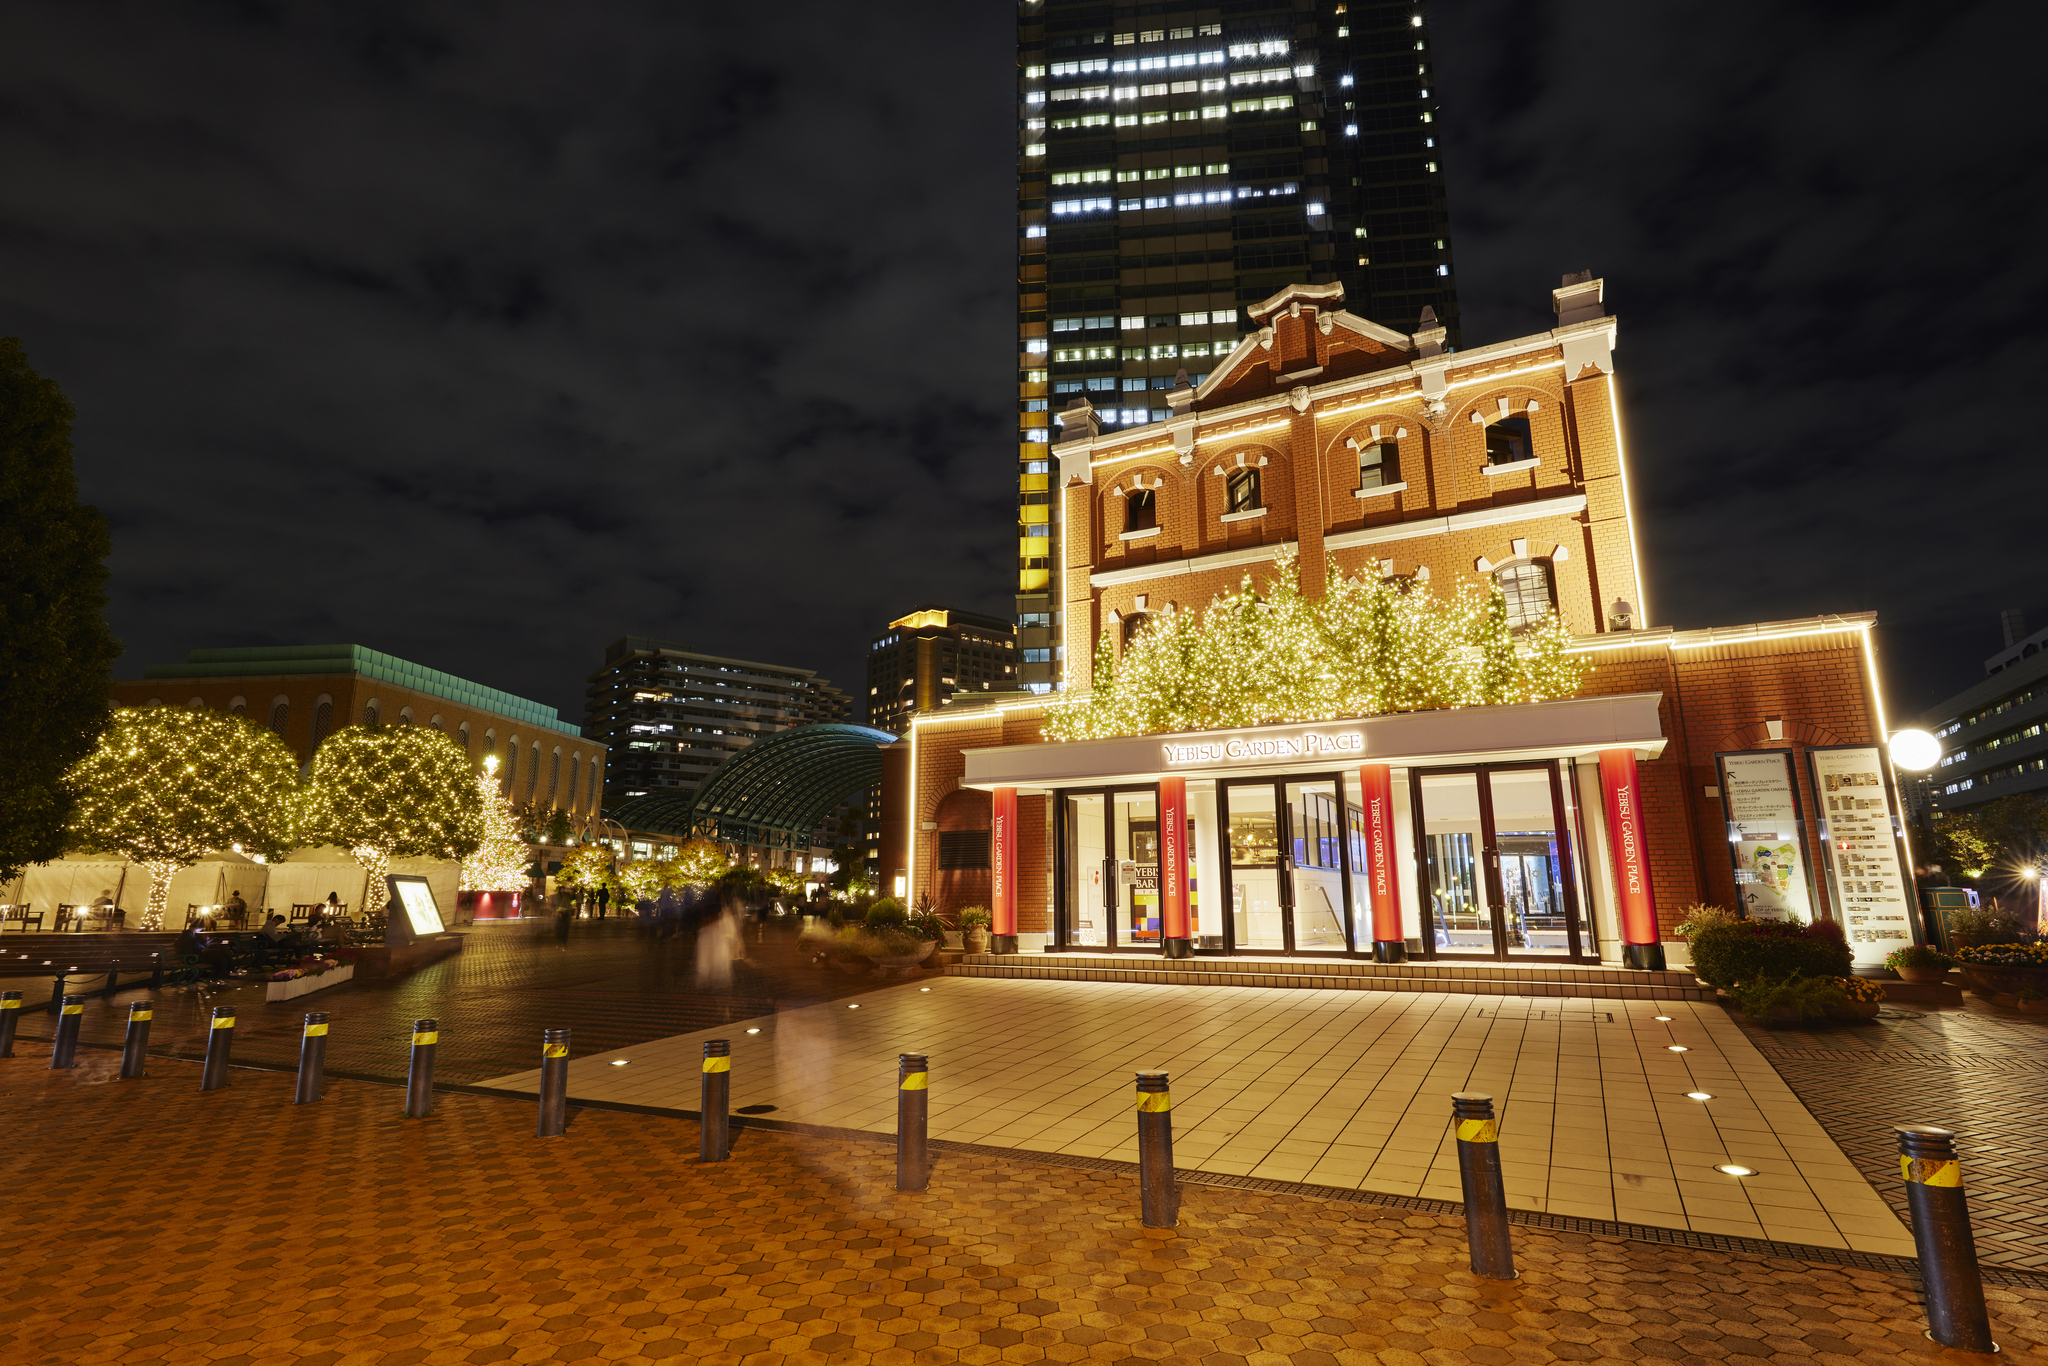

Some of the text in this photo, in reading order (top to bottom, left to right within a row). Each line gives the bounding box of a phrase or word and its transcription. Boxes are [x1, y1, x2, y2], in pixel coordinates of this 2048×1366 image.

[1164, 734, 1361, 762] YEBISU GARDEN PLACE
[996, 815, 1004, 841] YEBISU
[1617, 785, 1640, 894] YEBISU GARDEN PLACE
[1166, 807, 1176, 897] YEBISU GARDEN PLACE
[1371, 797, 1387, 896] YEBISU GARDEN PLACE
[1741, 853, 1748, 862] 1F
[1136, 879, 1155, 889] BAR
